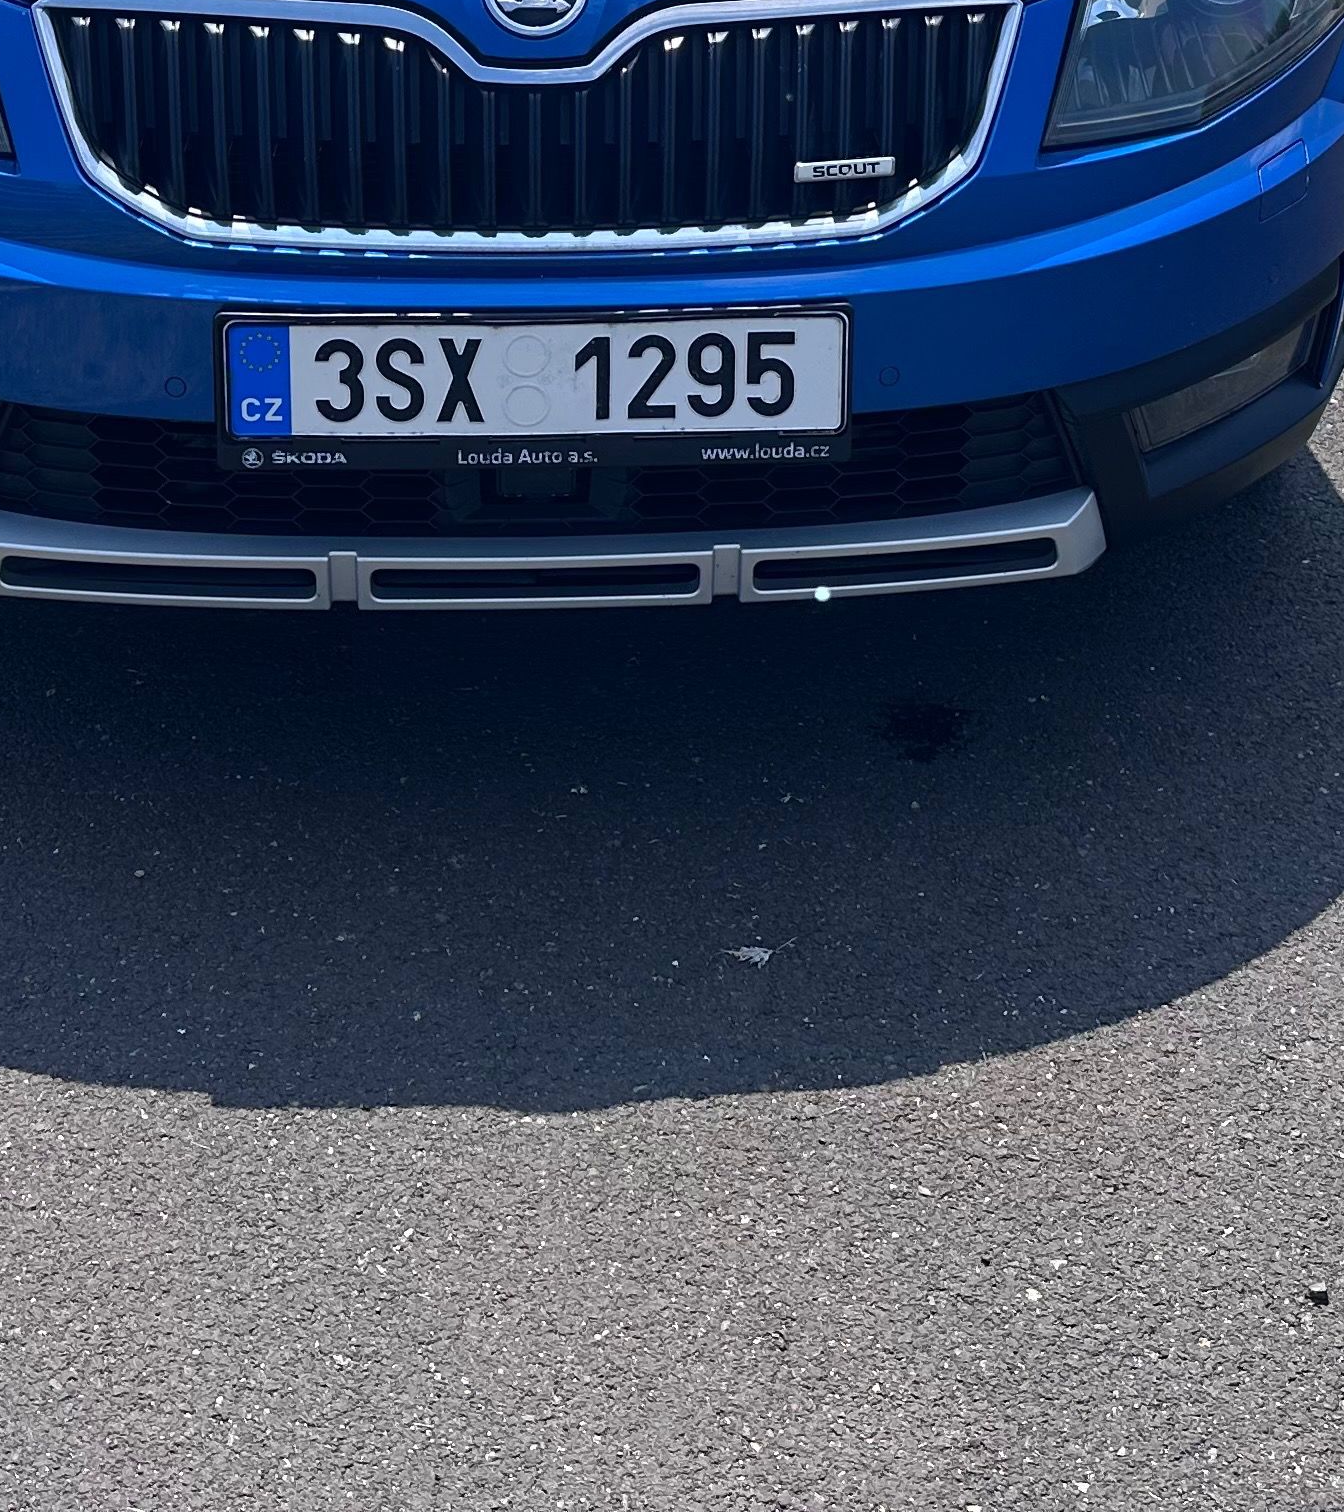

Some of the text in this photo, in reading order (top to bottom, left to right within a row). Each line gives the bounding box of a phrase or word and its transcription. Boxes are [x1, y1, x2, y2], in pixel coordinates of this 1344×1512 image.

[812, 161, 881, 178] SCOUT
[313, 330, 798, 424] 3SX 1295
[240, 398, 283, 422] CZ
[271, 450, 348, 464] ŠKODA
[457, 448, 598, 465] Louda Auto a.s.
[701, 441, 830, 460] www.louda.cz
